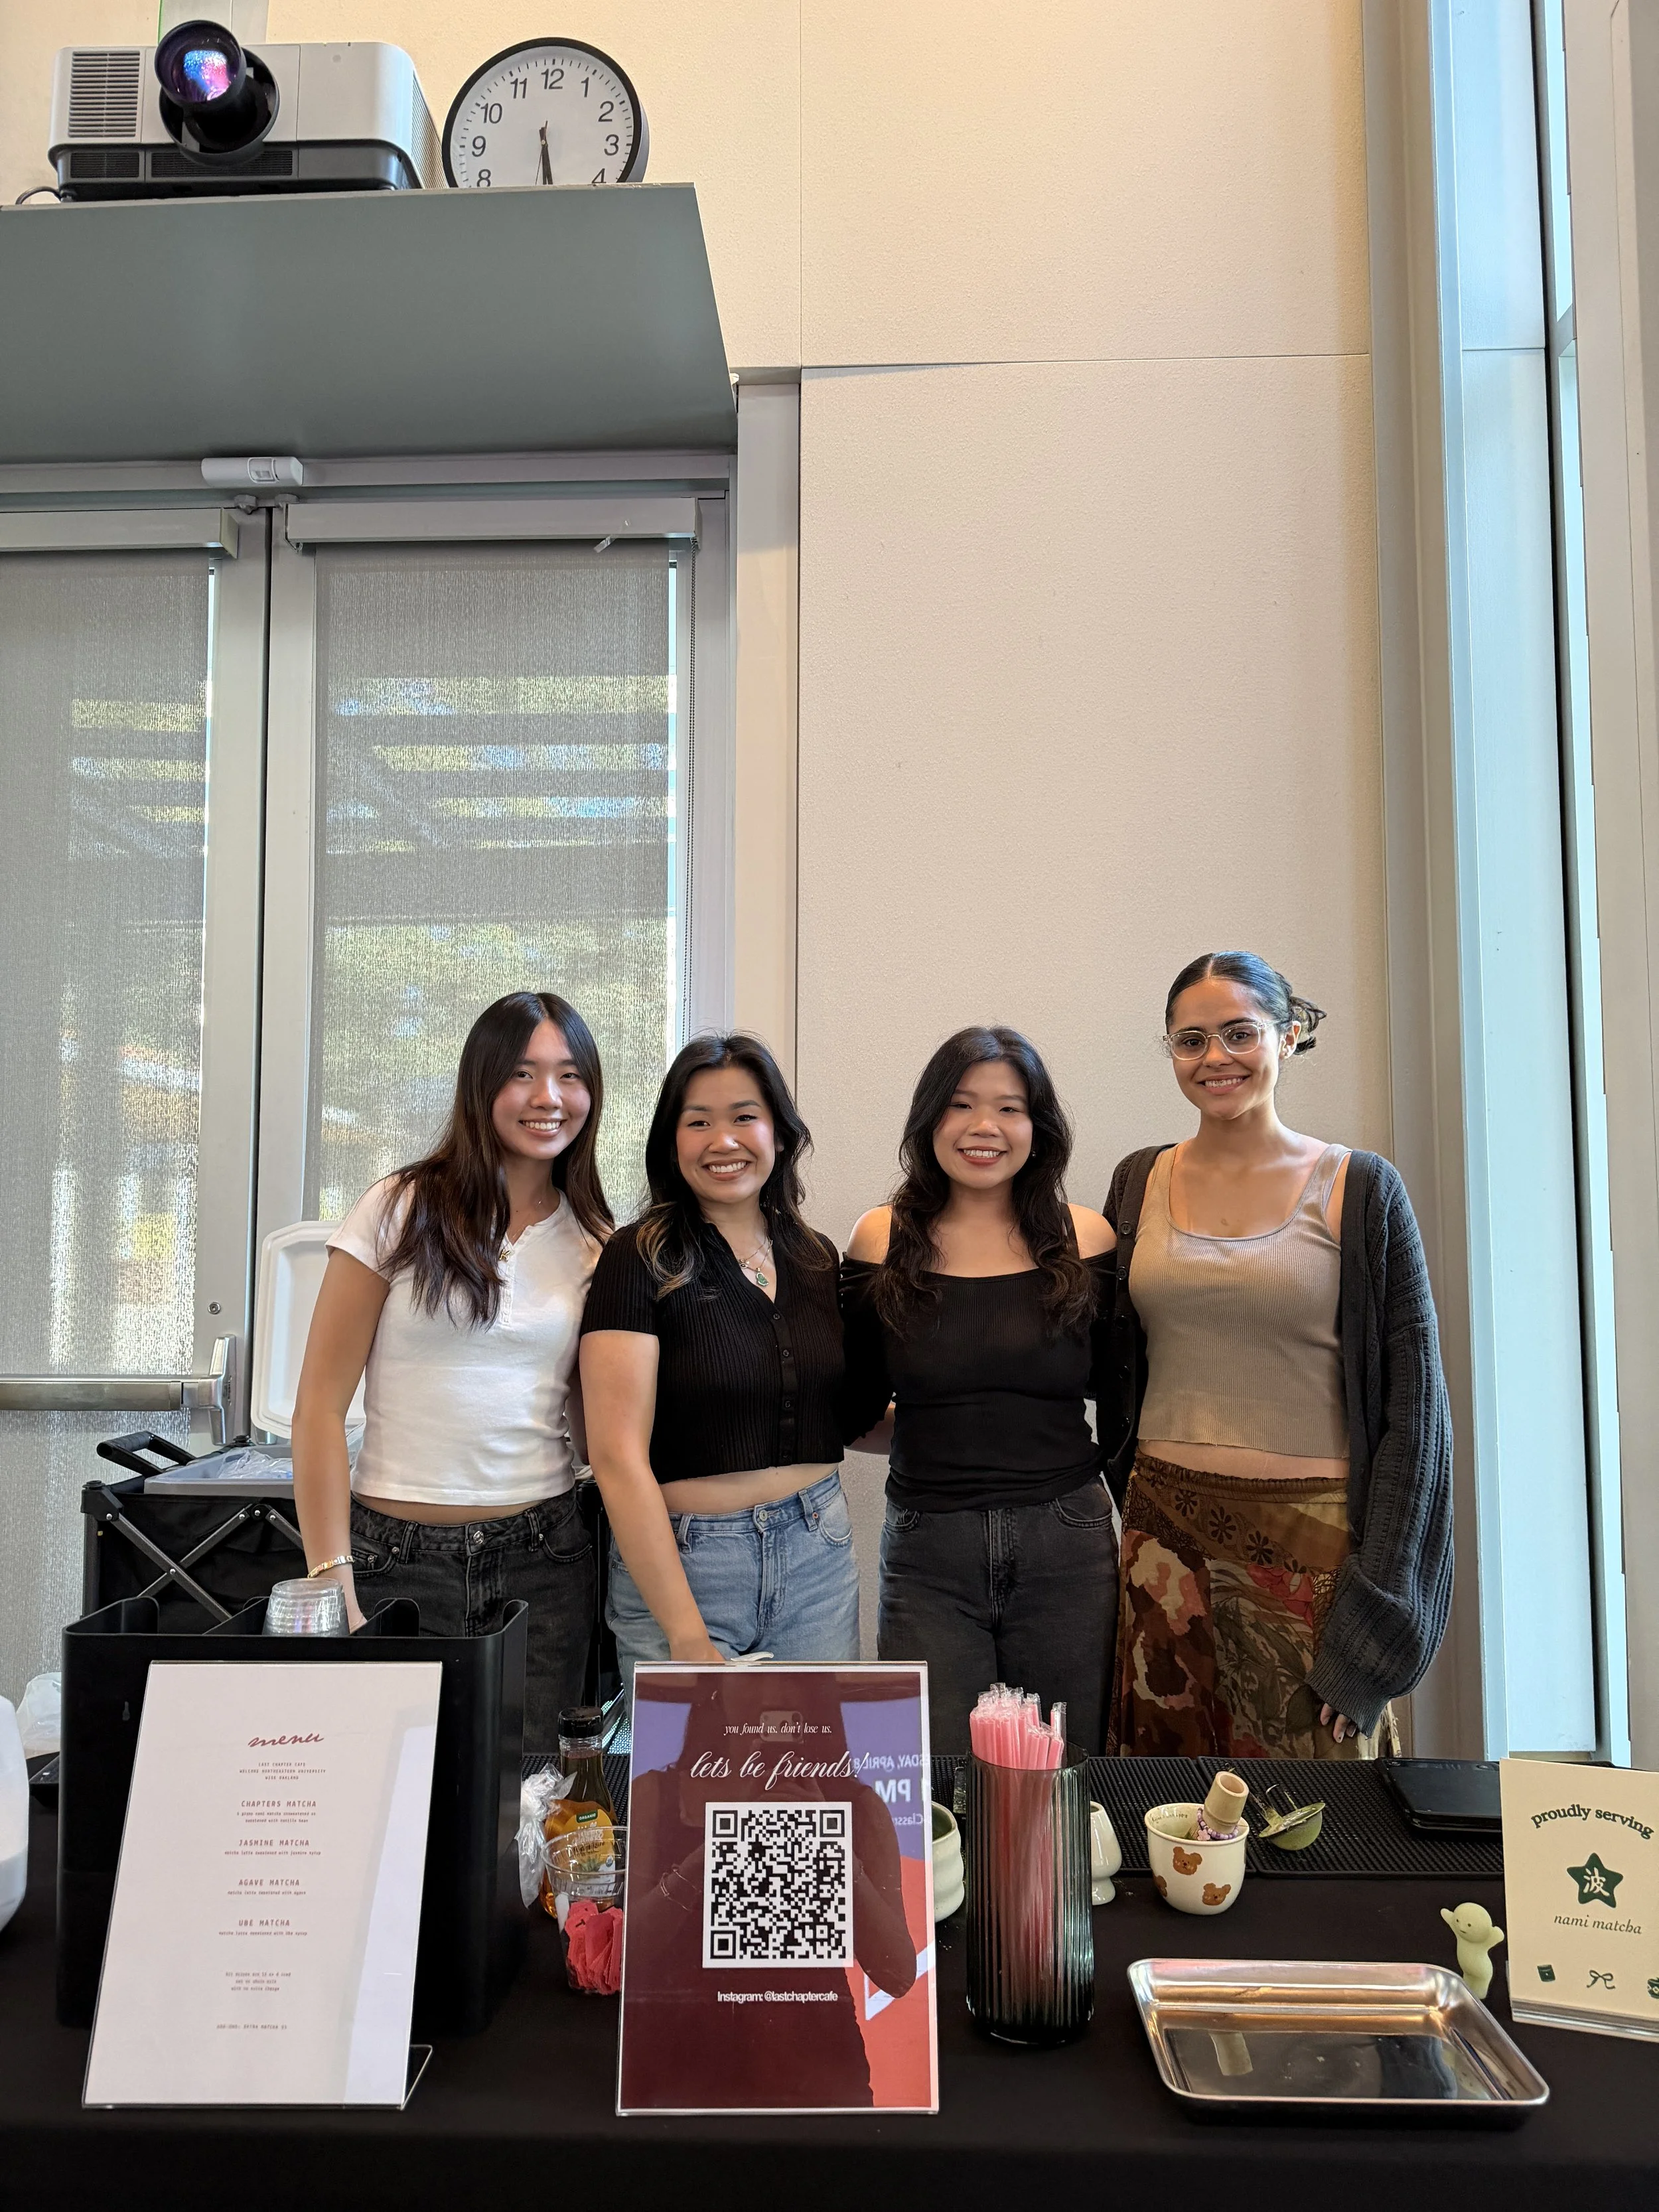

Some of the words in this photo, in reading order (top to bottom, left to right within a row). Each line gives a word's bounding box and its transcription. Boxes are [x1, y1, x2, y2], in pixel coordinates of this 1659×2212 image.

[510, 78, 528, 100] 11
[541, 68, 564, 90] 12
[581, 77, 590, 98] 1
[480, 102, 503, 125] 10
[599, 101, 614, 122] 2
[472, 135, 487, 157] 9
[604, 134, 620, 156] 3
[476, 169, 491, 187] 8
[592, 168, 607, 184] 4
[723, 1726, 739, 1735] you
[739, 1723, 764, 1735] found
[767, 1725, 778, 1733] us.
[804, 1723, 818, 1733] lose
[822, 1725, 832, 1733] us.
[248, 1733, 324, 1747] menu
[690, 1751, 732, 1778] lets
[739, 1751, 765, 1778] be
[764, 1751, 870, 1791] friends!
[1531, 1804, 1591, 1828] proudly
[1595, 1809, 1654, 1840] serving
[1583, 1867, 1611, 1897] 波
[1554, 1914, 1589, 1928] nami
[1592, 1919, 1642, 1935] matcha
[717, 1990, 763, 2004] Instagram:
[764, 1990, 839, 2004] @lastchaptercafe
